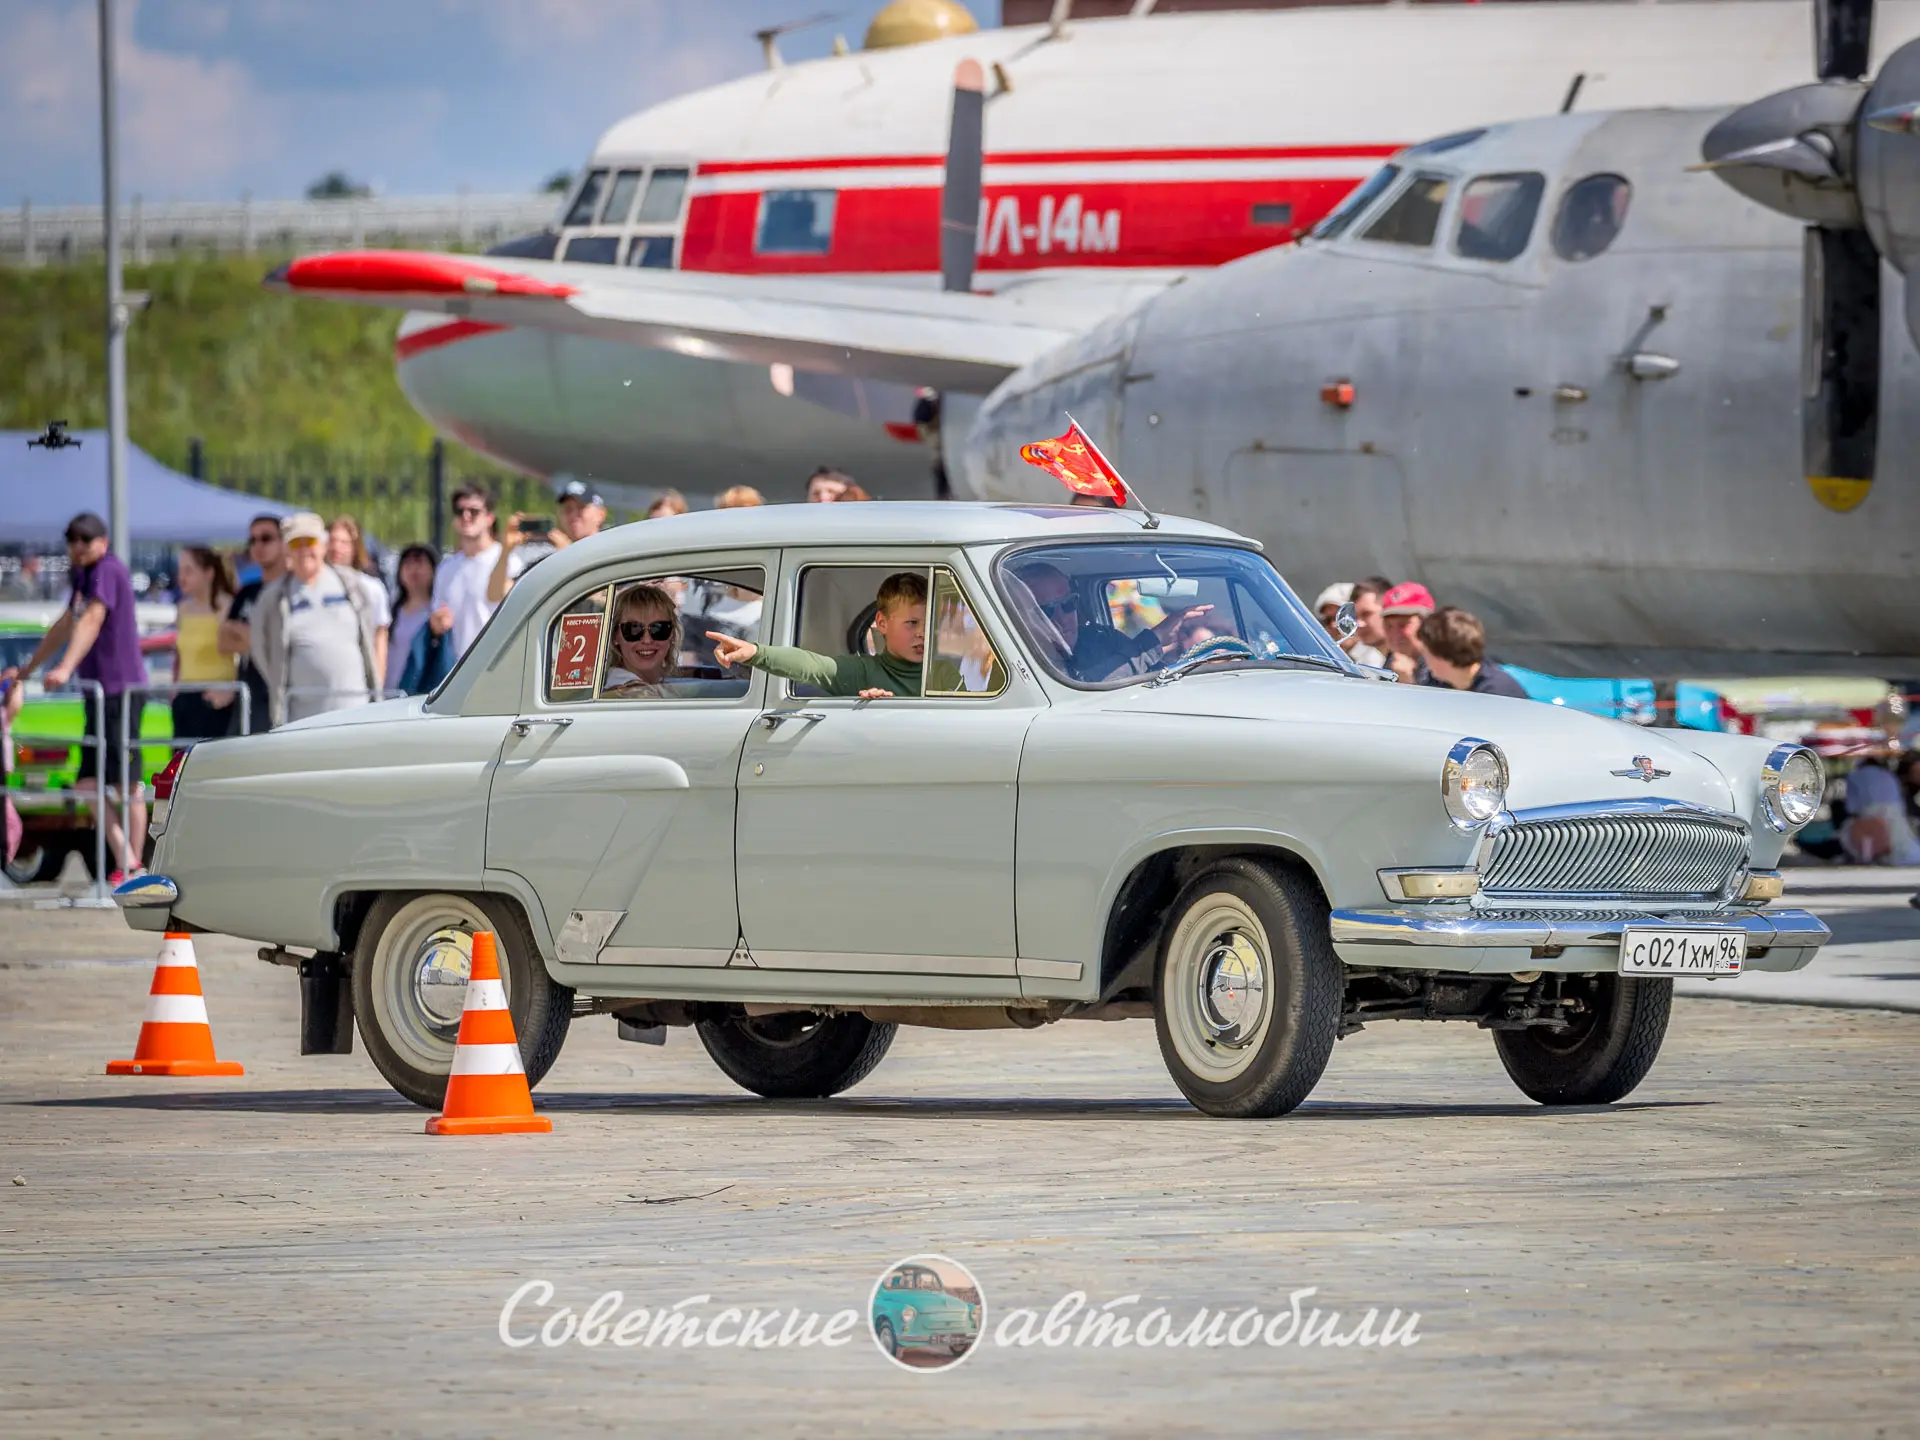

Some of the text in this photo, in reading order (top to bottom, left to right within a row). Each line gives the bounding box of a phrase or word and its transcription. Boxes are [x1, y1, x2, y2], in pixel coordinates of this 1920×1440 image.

[570, 635, 586, 663] 2
[1720, 937, 1737, 960] 96
[1715, 960, 1729, 969] RUS
